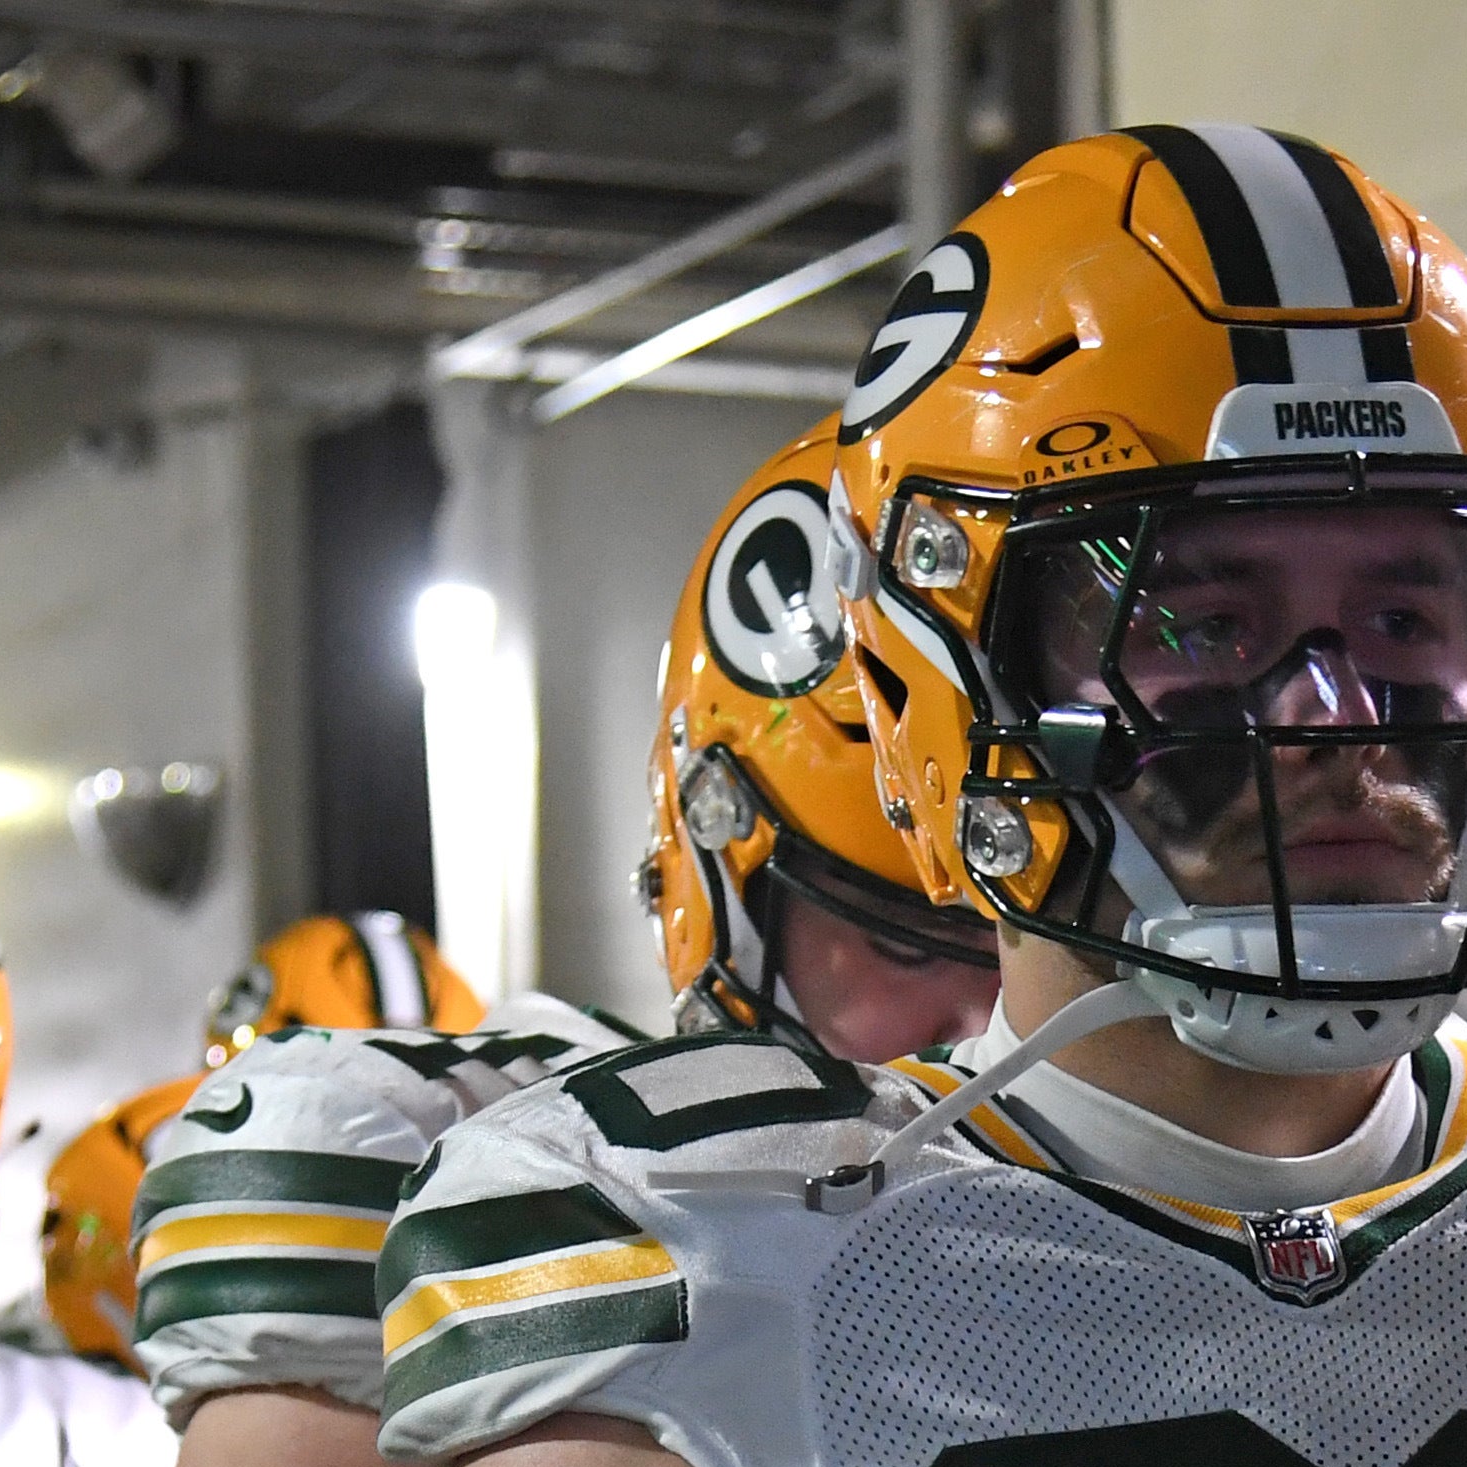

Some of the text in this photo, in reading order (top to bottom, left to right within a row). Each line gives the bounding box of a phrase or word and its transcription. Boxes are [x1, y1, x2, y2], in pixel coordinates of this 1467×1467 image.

[1274, 400, 1406, 440] PACKERS
[1023, 445, 1140, 484] OAKLEY
[1268, 1240, 1333, 1280] NFL
